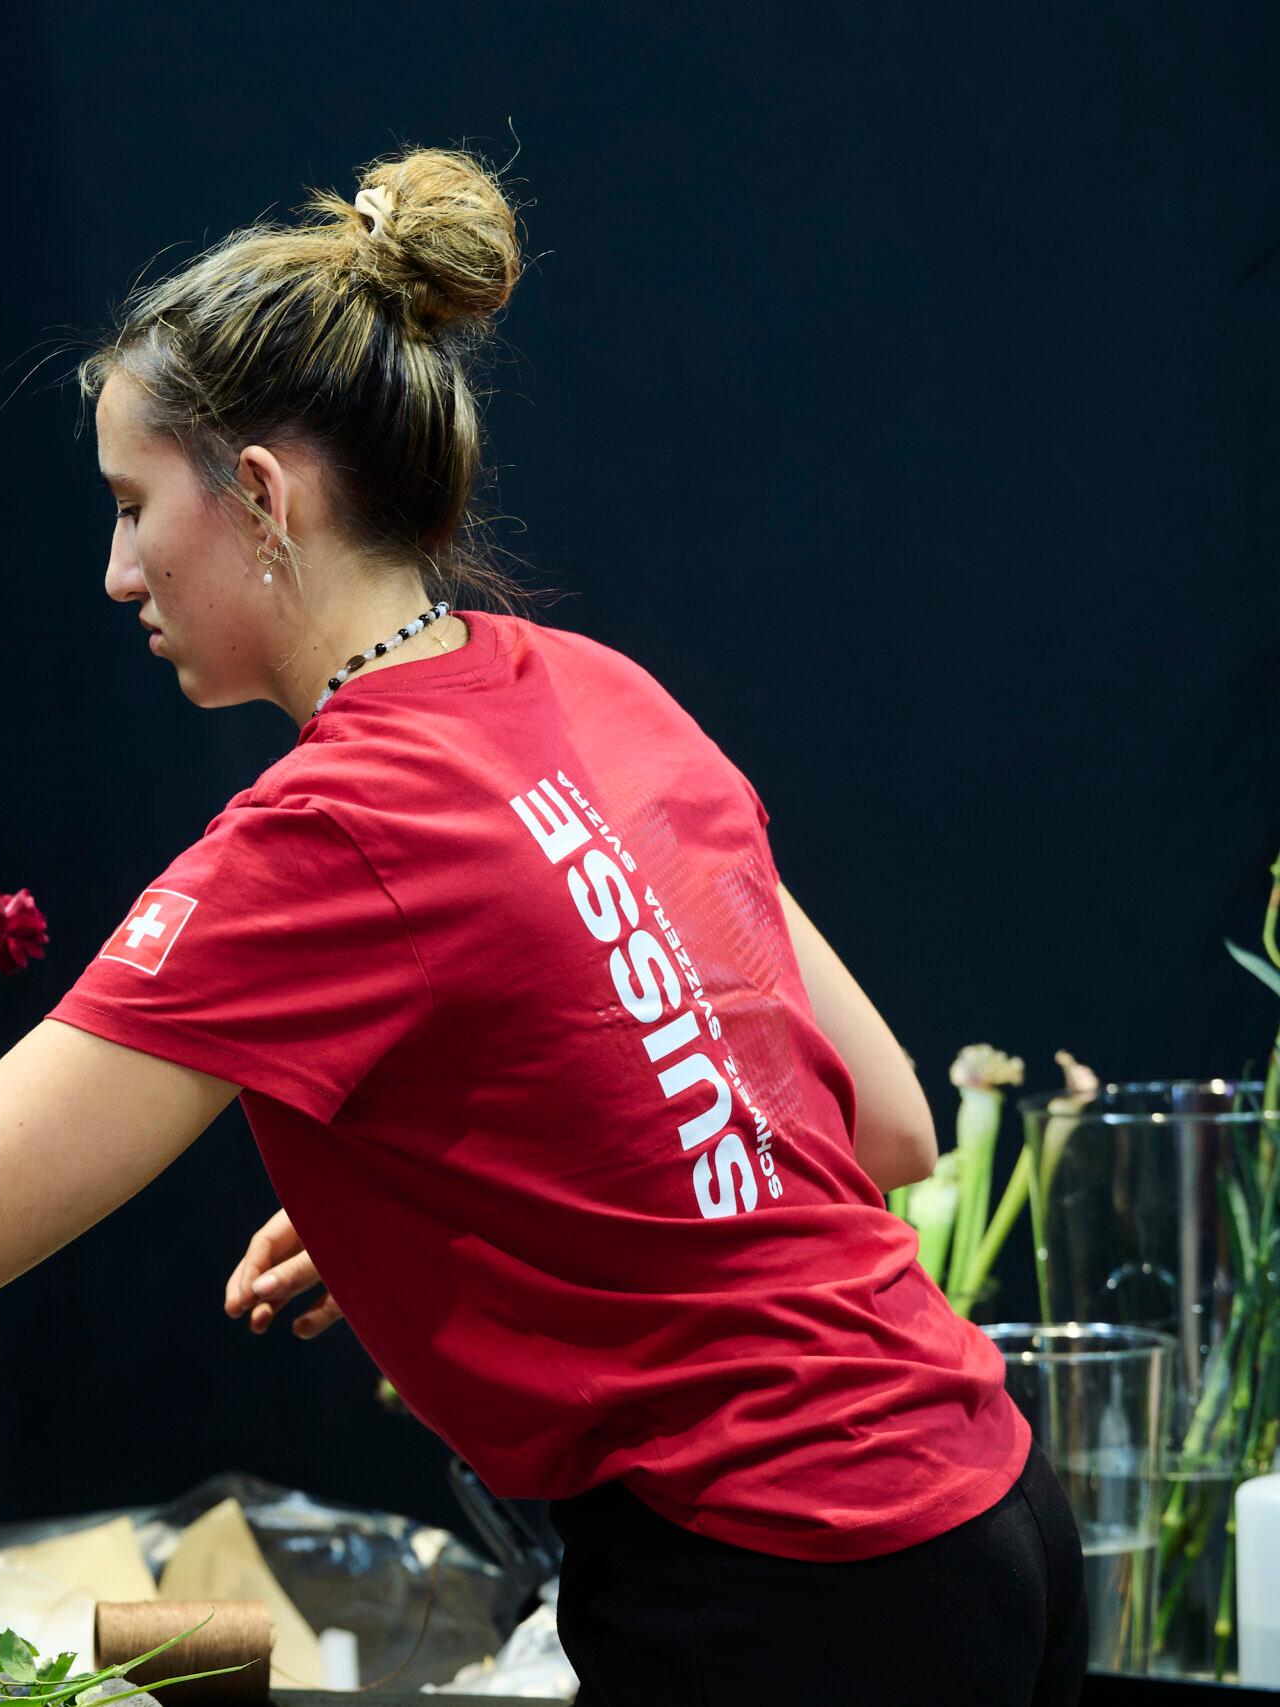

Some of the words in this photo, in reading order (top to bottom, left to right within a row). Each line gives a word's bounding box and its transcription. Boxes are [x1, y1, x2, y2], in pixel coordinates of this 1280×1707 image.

[557, 769, 638, 873] SVIZRA
[509, 777, 758, 1219] SUISSE
[644, 884, 722, 1041] SVIZZERA
[723, 1055, 784, 1200] SCHWEIZ
